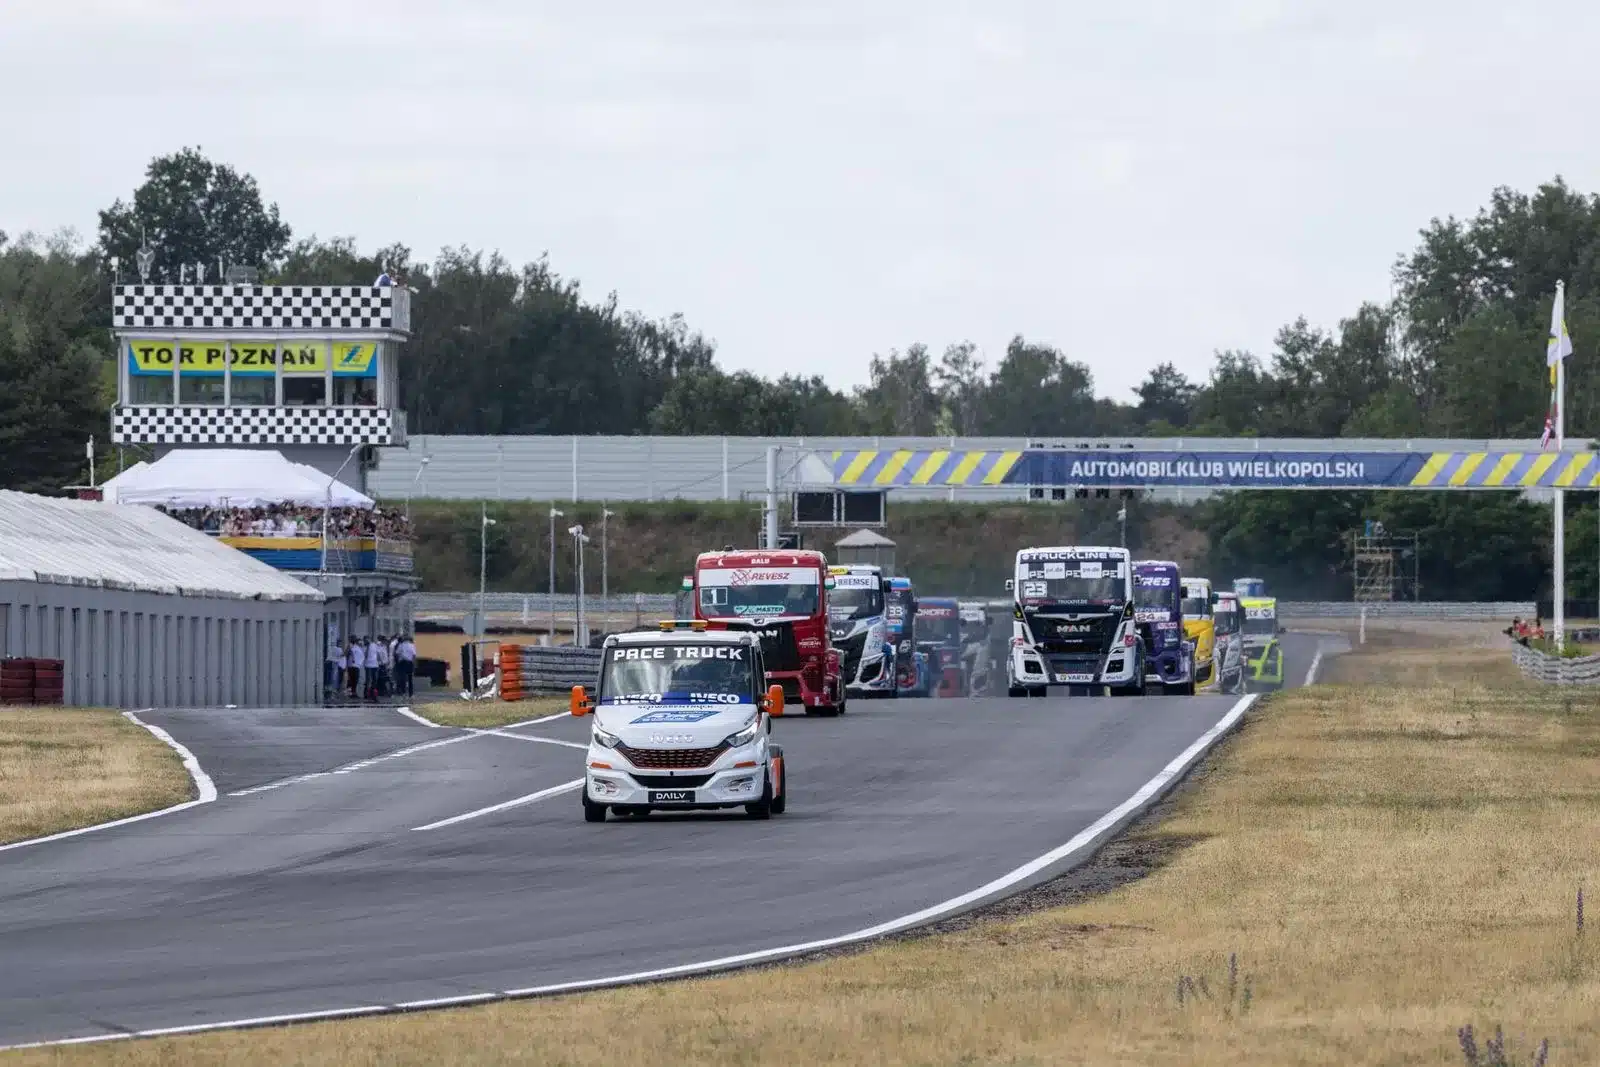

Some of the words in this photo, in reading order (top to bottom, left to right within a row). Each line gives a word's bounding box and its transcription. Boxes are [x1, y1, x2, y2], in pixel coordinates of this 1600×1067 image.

[138, 348, 194, 364] TOR
[206, 345, 316, 365] POZNAŃ
[1070, 460, 1224, 478] AUTOMOBILKLUB
[1228, 461, 1365, 478] WIELKOPOLSKI
[710, 588, 718, 604] 1
[1025, 583, 1047, 597] 23
[1057, 624, 1090, 633] MAN
[613, 648, 665, 661] PACE
[674, 647, 742, 660] TRUCK
[614, 693, 662, 705] IVECO
[690, 693, 740, 704] IVECO
[650, 733, 695, 743] IVECO
